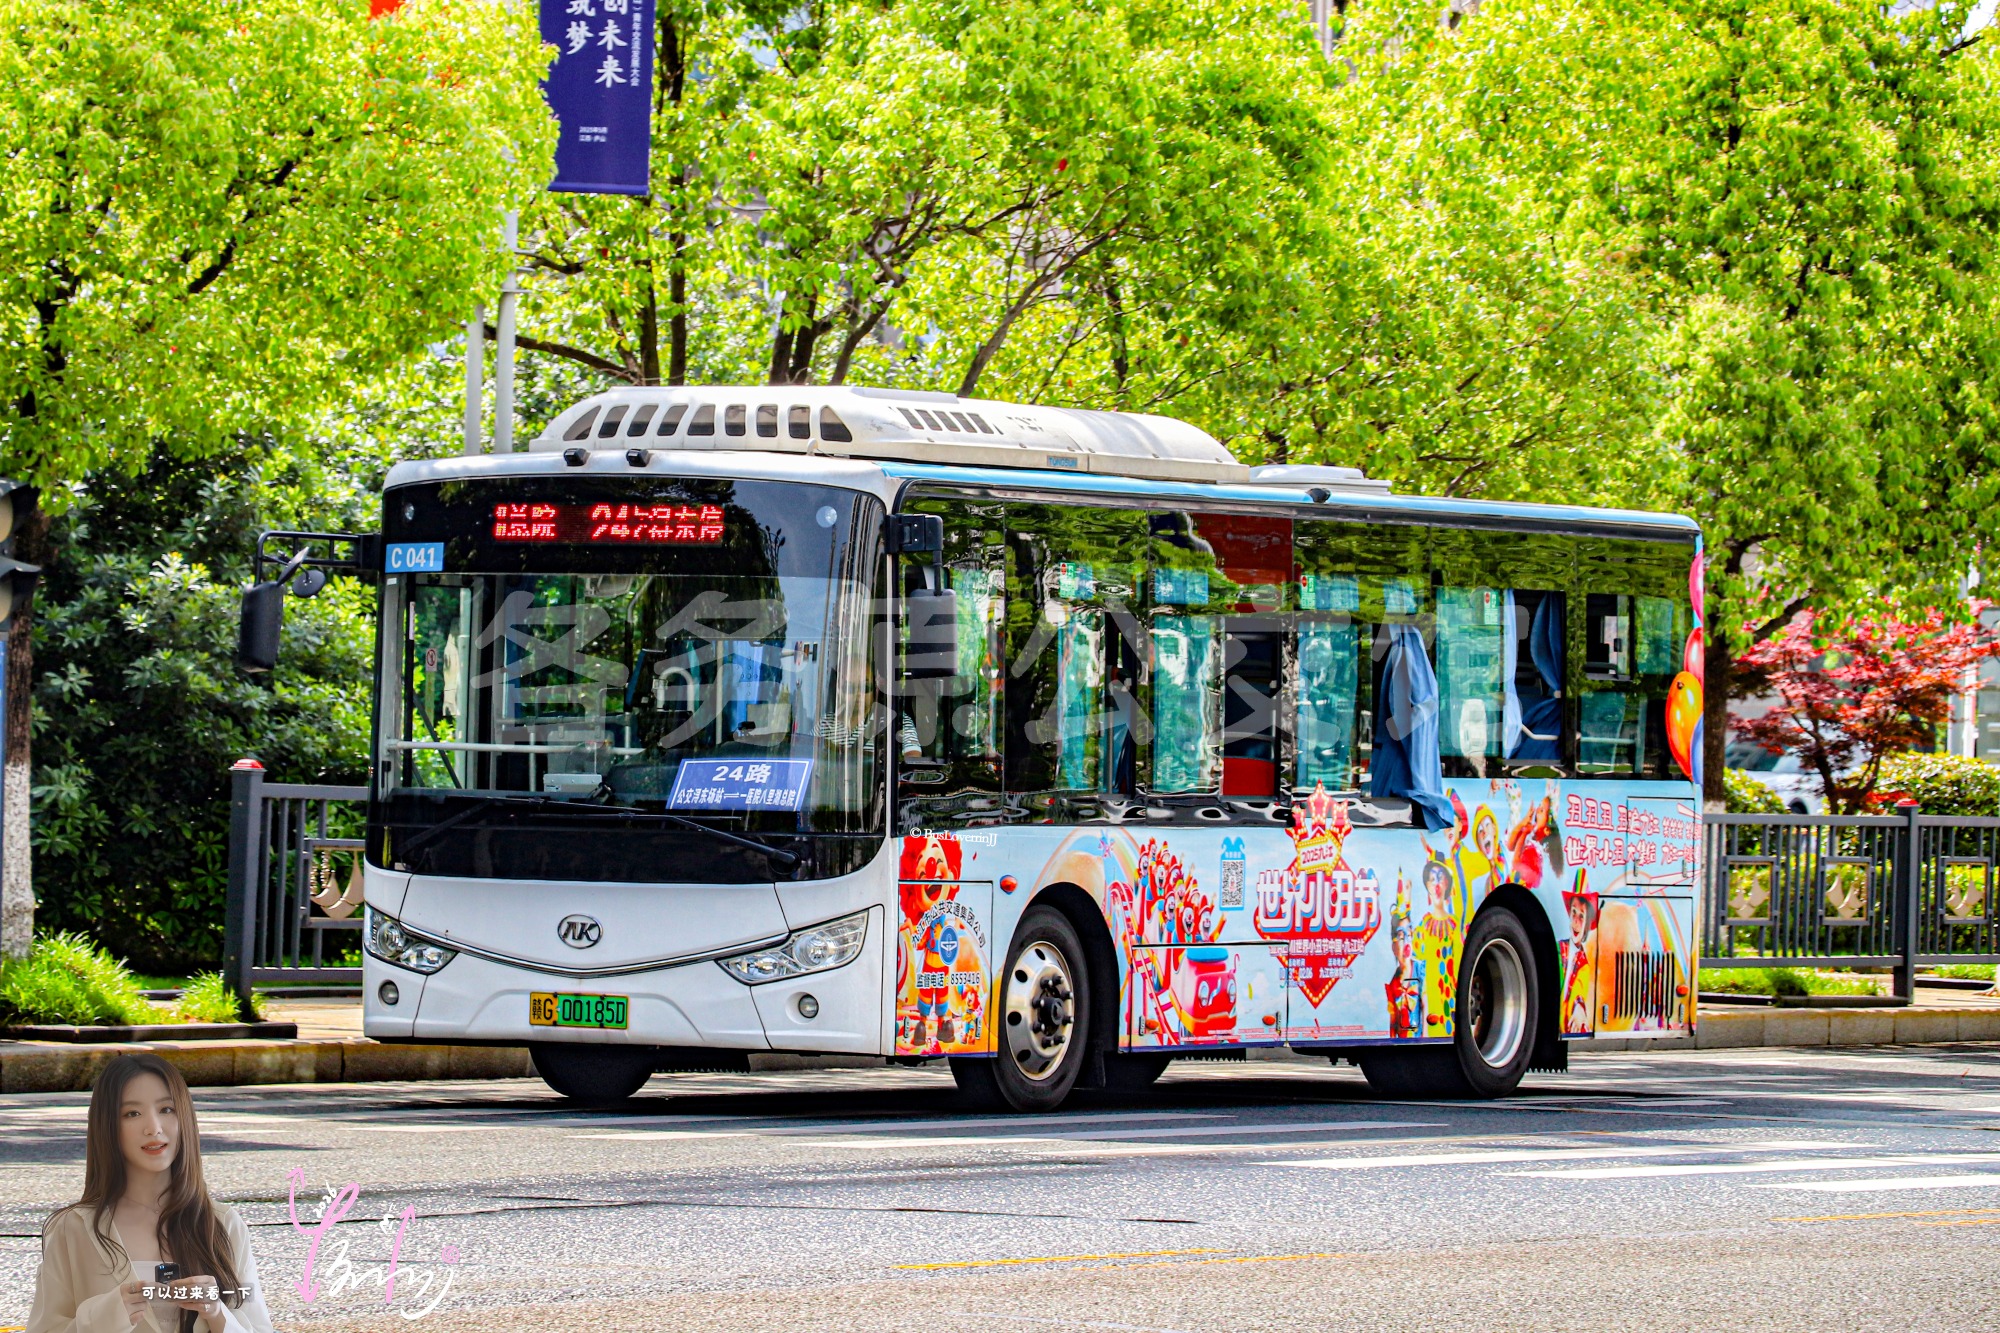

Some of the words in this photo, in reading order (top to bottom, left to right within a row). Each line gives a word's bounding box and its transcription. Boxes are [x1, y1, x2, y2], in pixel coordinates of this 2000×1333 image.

[406, 546, 436, 568] 041
[711, 764, 771, 784] 24路
[1256, 870, 1380, 932] 世界小丑节
[911, 900, 987, 949] 九江市公共交通集团公司
[562, 999, 625, 1024] 00185D
